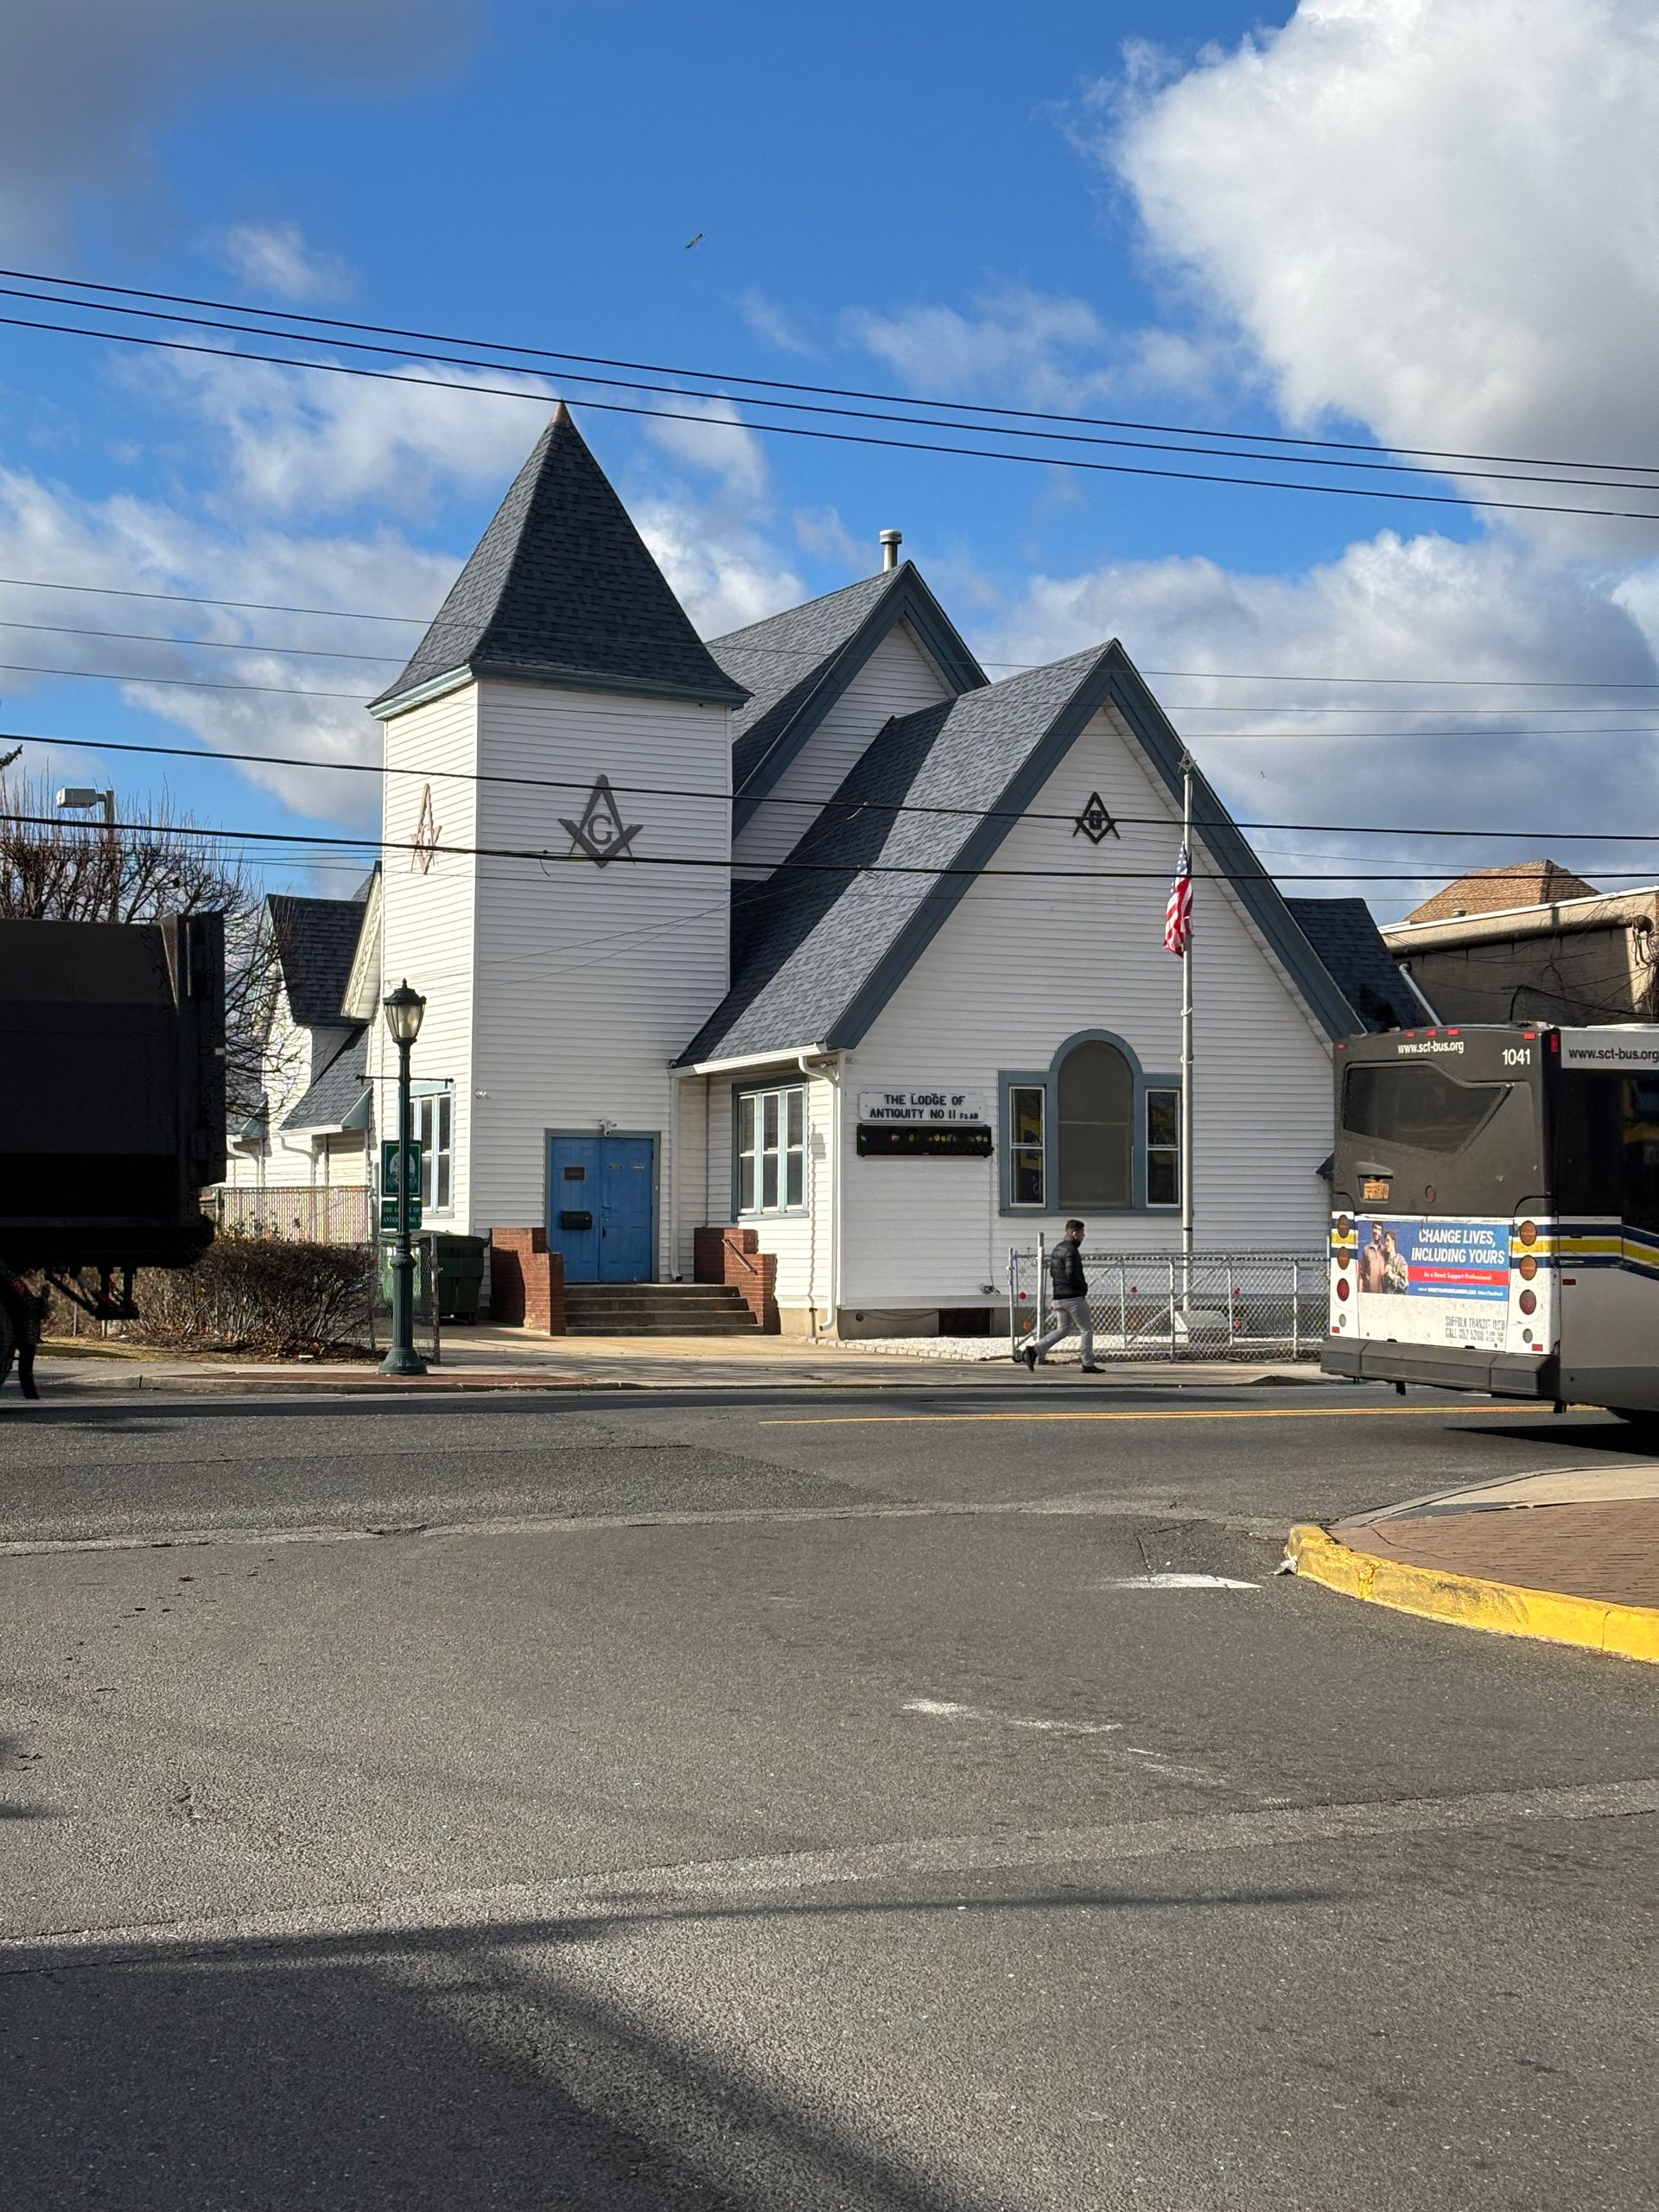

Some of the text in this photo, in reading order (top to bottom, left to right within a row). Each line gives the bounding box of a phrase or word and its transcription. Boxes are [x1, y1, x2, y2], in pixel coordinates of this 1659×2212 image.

[588, 815, 613, 844] G
[1397, 1040, 1465, 1054] www.sct-bus.org
[1568, 1046, 1659, 1063] www.sct-bus.org
[1502, 1048, 1531, 1065] 1041
[884, 1093, 966, 1106] THE LODGE OF
[869, 1108, 925, 1119] ANTIQUITY
[930, 1109, 944, 1120] NO
[1419, 1229, 1496, 1248] CHANGE LIVES,
[1411, 1248, 1505, 1264] INCLUDING YOURS
